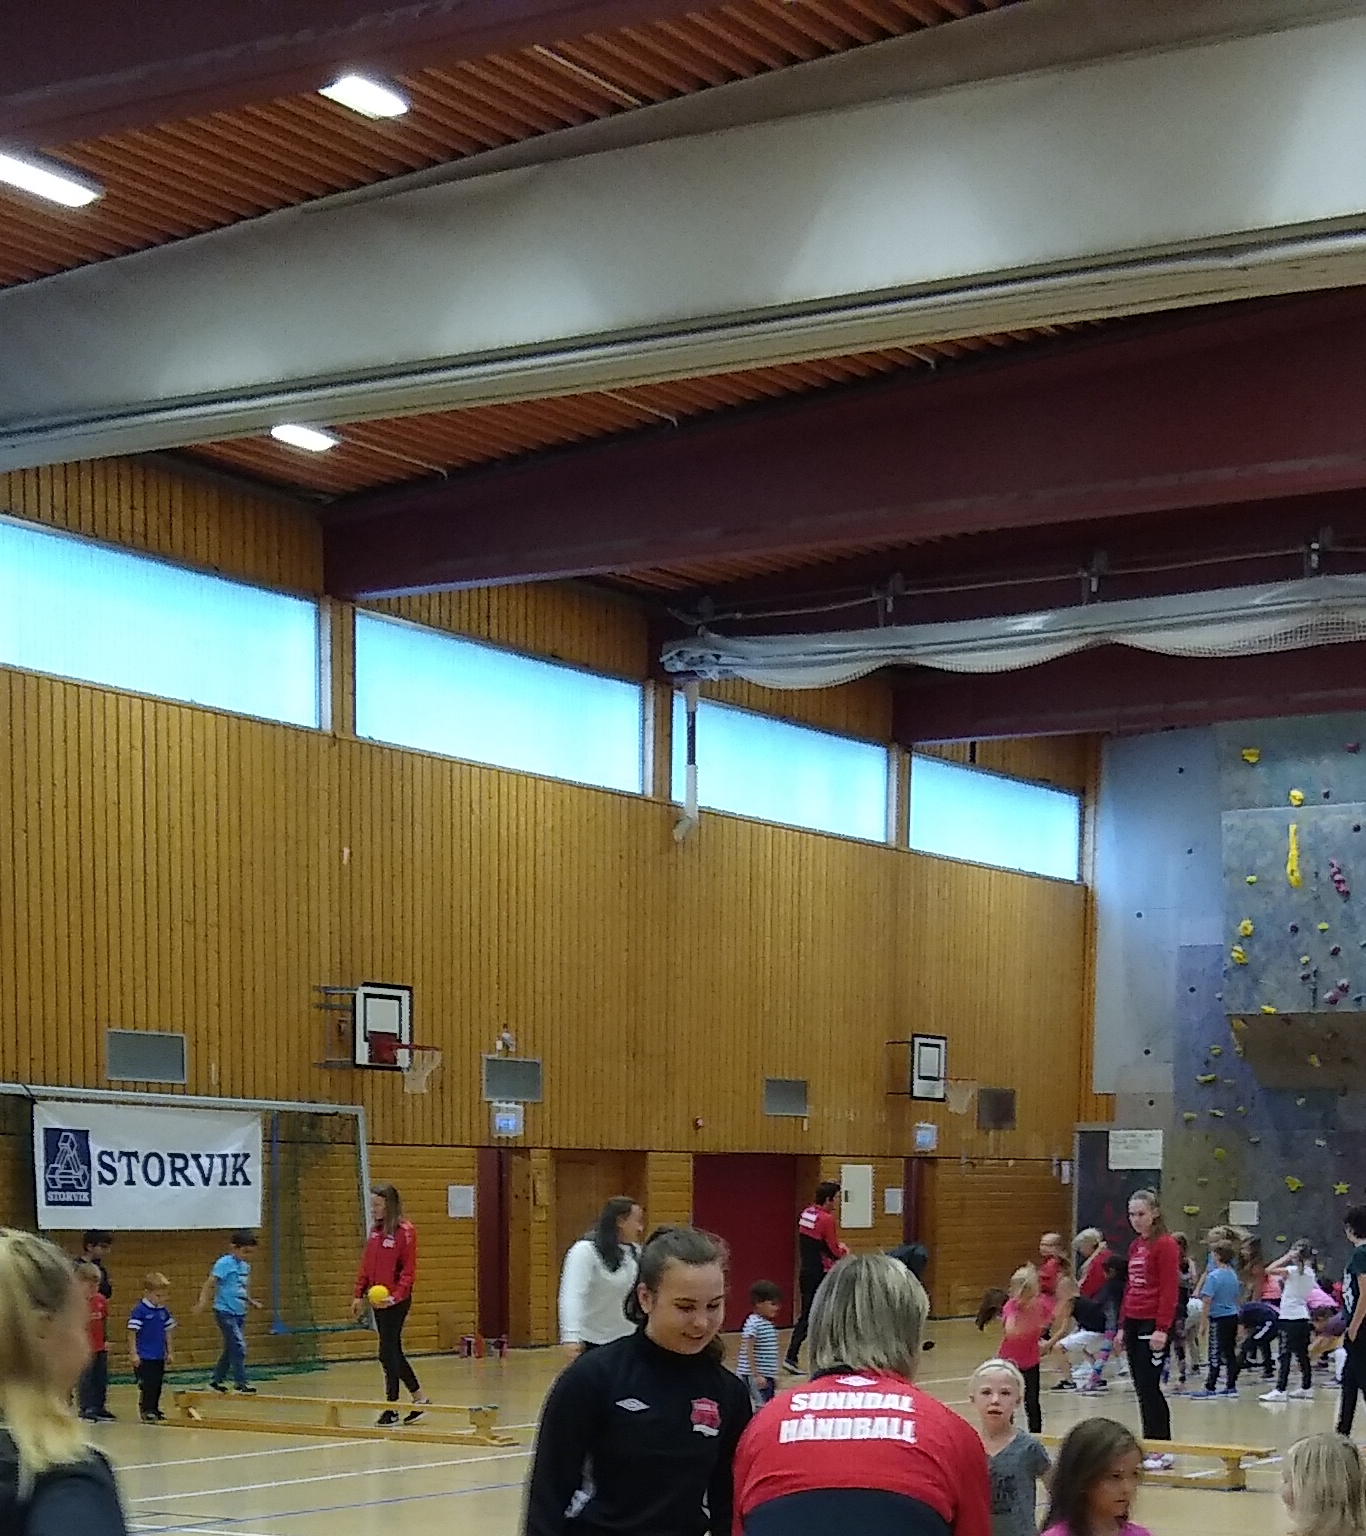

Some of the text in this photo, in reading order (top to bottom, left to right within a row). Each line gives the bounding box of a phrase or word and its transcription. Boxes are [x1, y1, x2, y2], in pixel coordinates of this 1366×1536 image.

[97, 1151, 252, 1187] STORVIK
[47, 1191, 90, 1202] STORVIK
[790, 1391, 915, 1413] SUNNDAL
[779, 1413, 917, 1444] HÅNDBALL
